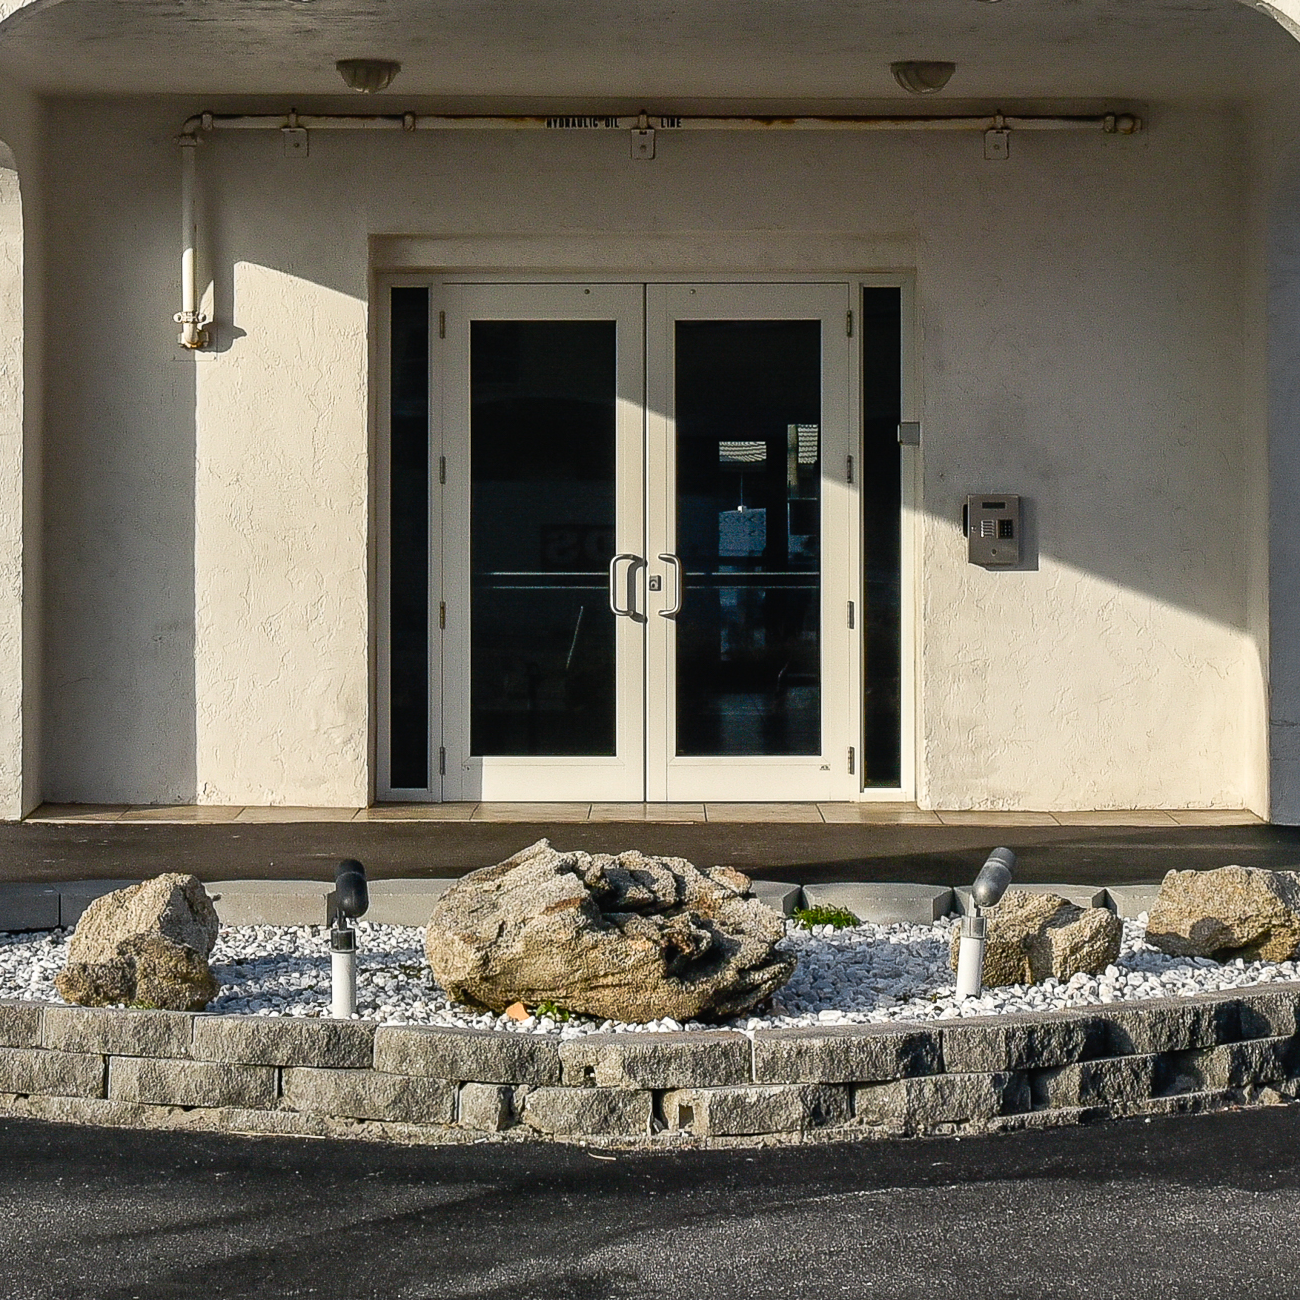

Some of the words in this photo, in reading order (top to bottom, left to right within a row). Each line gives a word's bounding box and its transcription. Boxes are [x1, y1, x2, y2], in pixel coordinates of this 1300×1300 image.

[546, 117, 599, 129] HYDRAULIC
[604, 117, 620, 129] OIL
[660, 117, 682, 129] LINE
